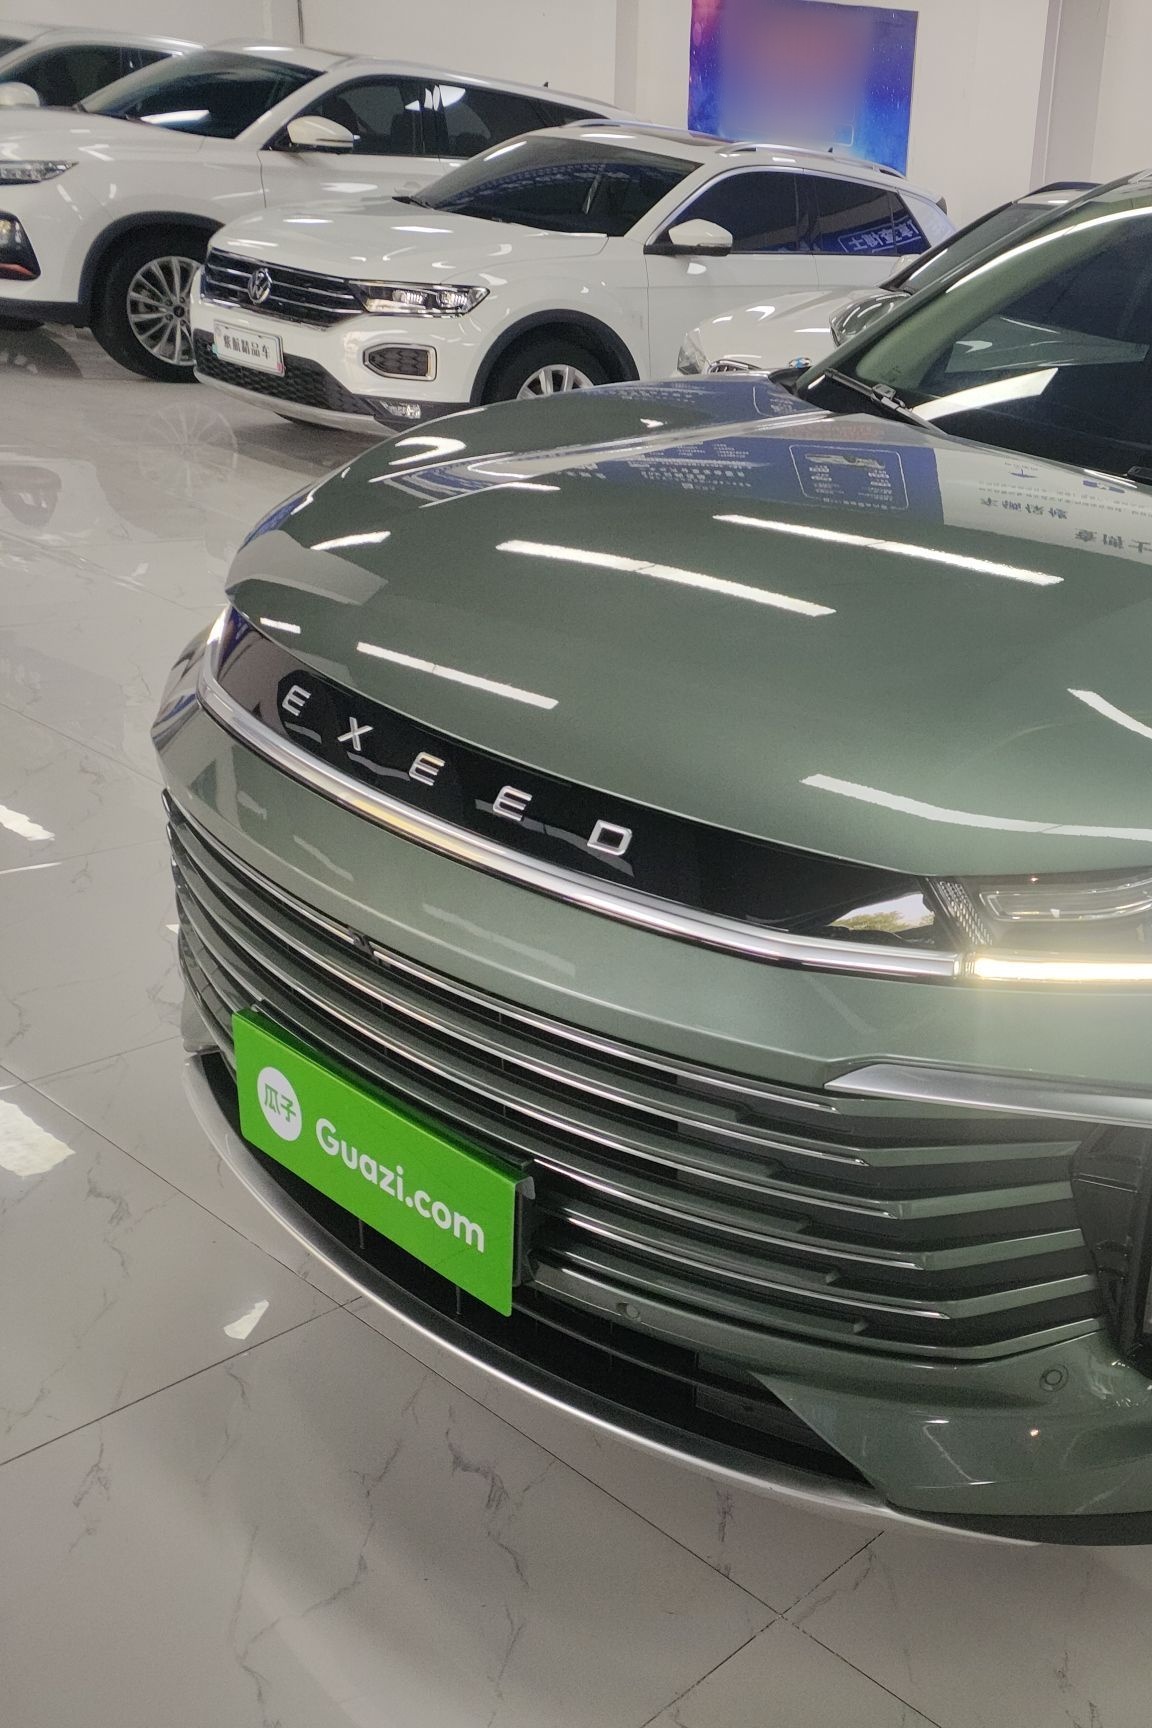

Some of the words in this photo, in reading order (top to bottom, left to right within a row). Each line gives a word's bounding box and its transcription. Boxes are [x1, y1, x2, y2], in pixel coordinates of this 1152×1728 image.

[281, 683, 633, 857] EXEED
[263, 1080, 299, 1125] 瓜子
[315, 1116, 486, 1253] Guazi.com
